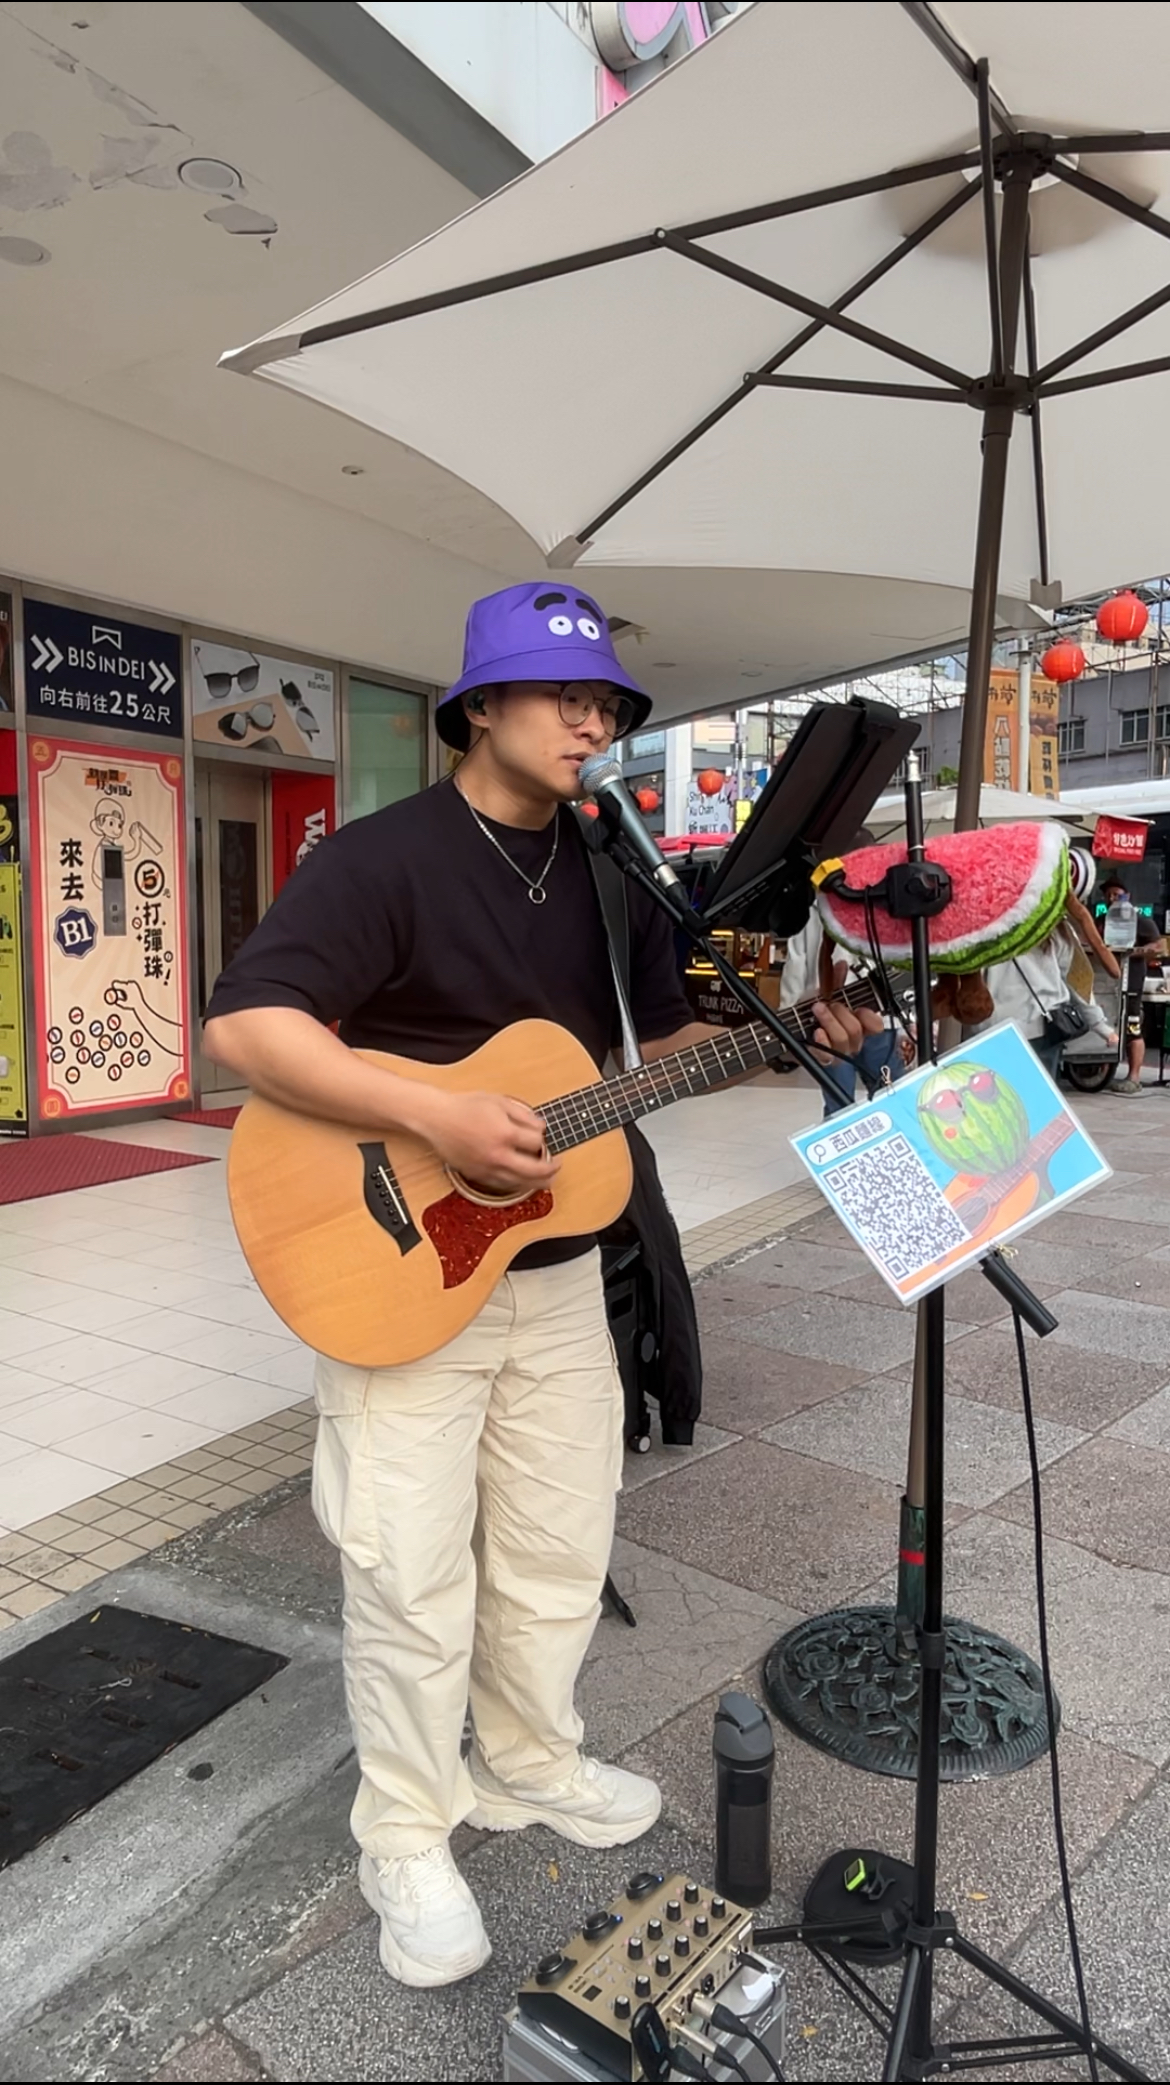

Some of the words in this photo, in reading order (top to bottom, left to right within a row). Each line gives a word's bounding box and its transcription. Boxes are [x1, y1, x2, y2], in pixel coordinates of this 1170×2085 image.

[40, 684, 171, 725] 向右前往25公尺
[59, 838, 85, 901] 來去
[60, 917, 93, 947] B1
